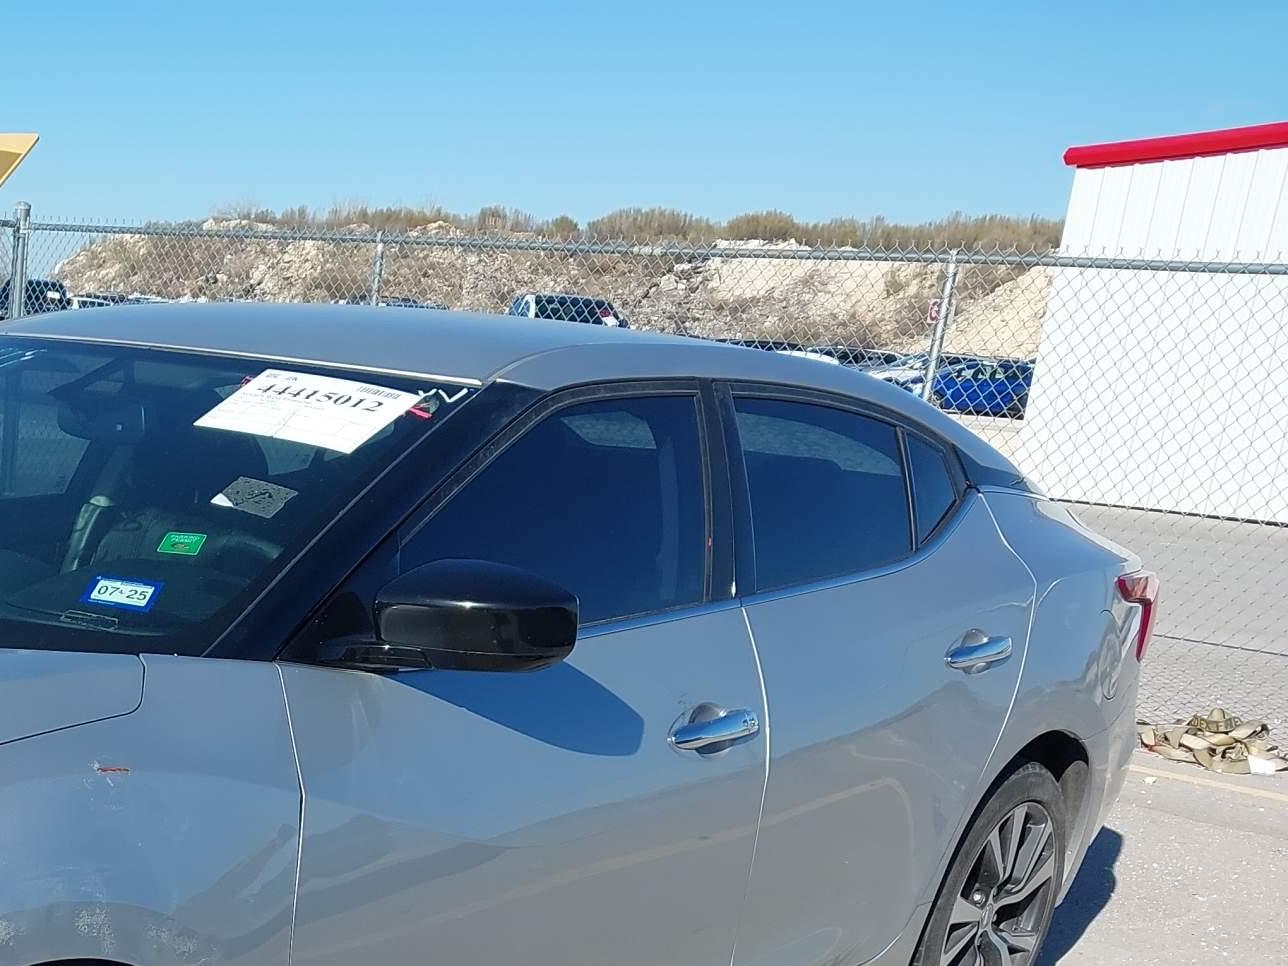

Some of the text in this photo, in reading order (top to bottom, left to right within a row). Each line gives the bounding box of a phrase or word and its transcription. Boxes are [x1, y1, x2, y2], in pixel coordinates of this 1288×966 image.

[257, 384, 384, 412] 44415012
[97, 585, 149, 601] 07 25
